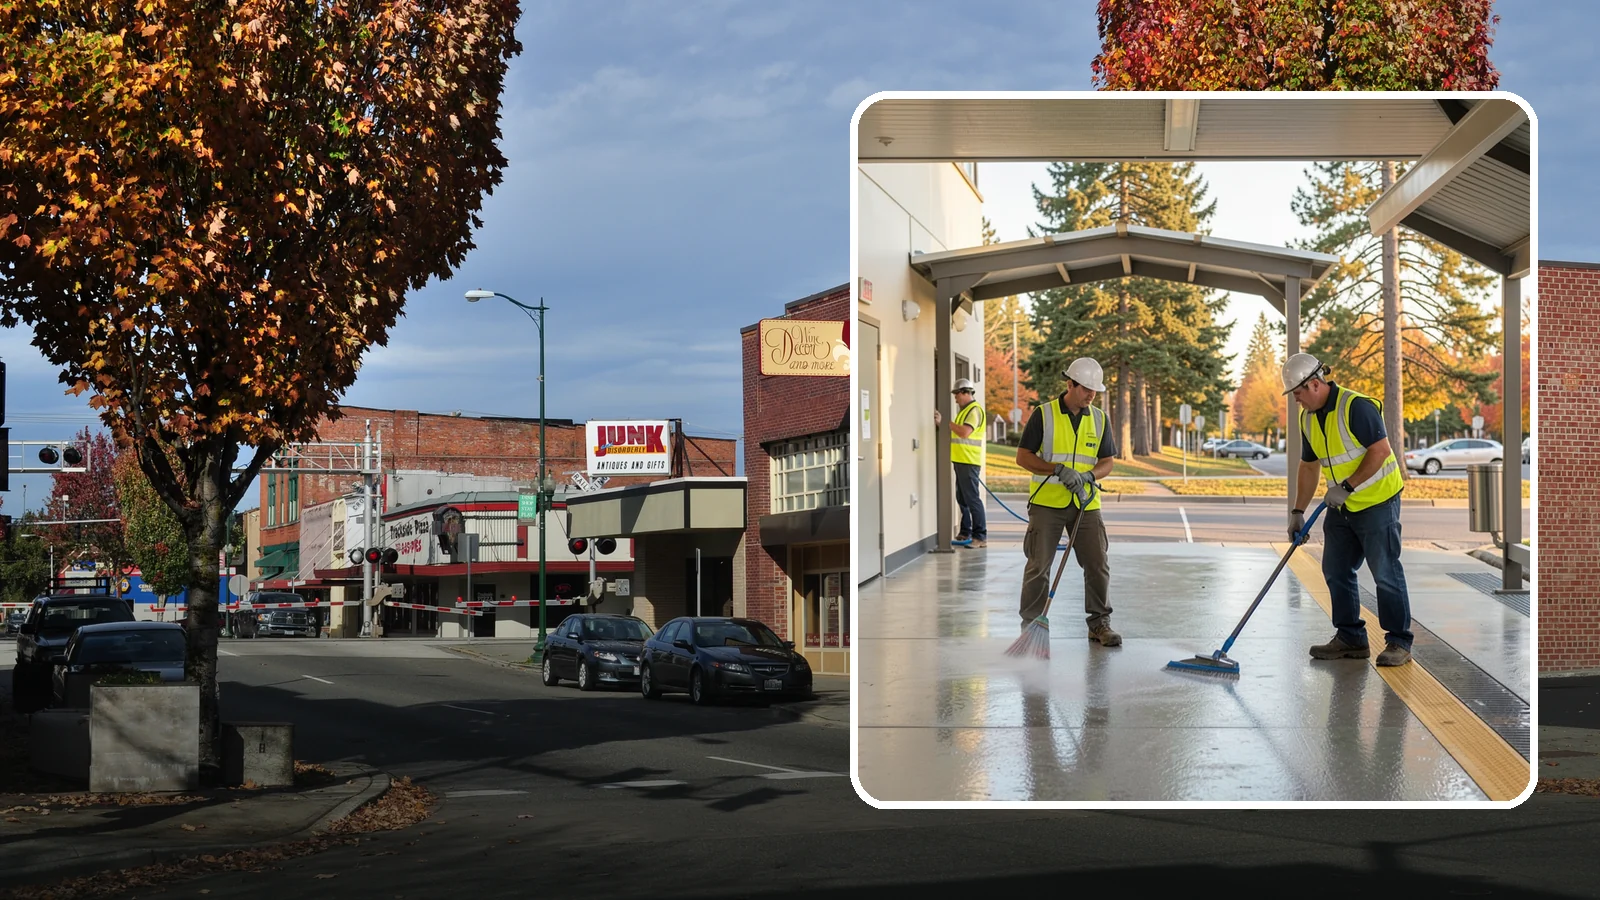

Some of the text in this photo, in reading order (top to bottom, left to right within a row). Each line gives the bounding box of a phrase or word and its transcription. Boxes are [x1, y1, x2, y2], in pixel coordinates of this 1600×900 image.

[765, 327, 831, 366] Decor
[595, 425, 664, 457] JUNK
[597, 460, 665, 470] ANTIQUES AND GIFTS
[573, 473, 588, 490] RAIL
[390, 520, 429, 539] Trackside Pizza
